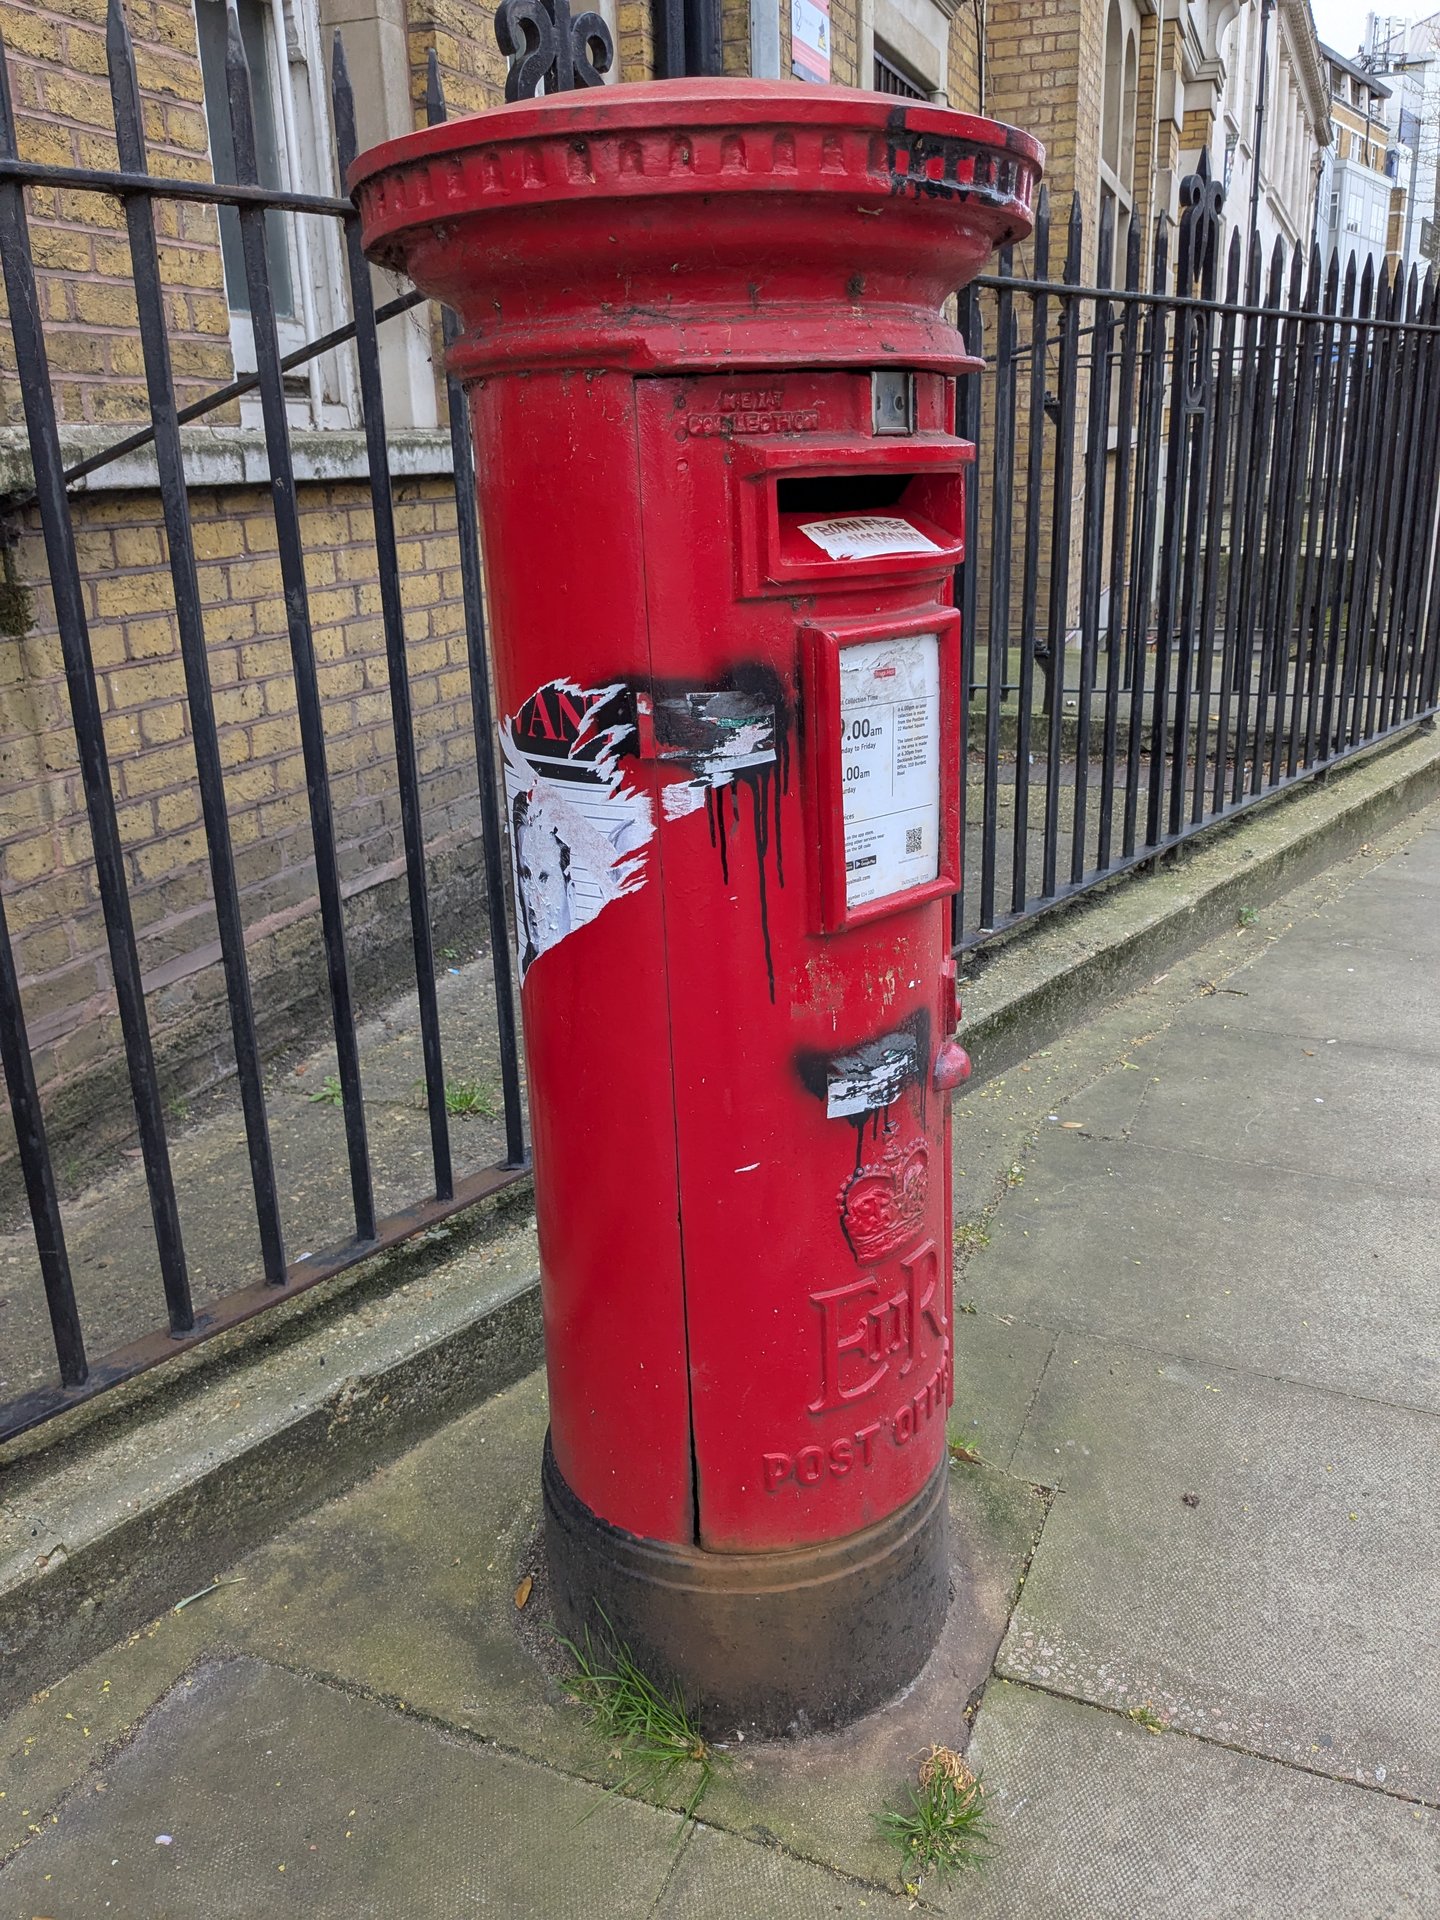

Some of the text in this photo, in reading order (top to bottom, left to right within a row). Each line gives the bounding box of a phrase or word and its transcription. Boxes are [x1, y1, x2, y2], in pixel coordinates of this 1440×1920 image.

[813, 519, 867, 537] BORN
[860, 518, 911, 531] FREE
[845, 696, 867, 705] Collection
[861, 743, 876, 751] Friday
[762, 1421, 881, 1493] POST
